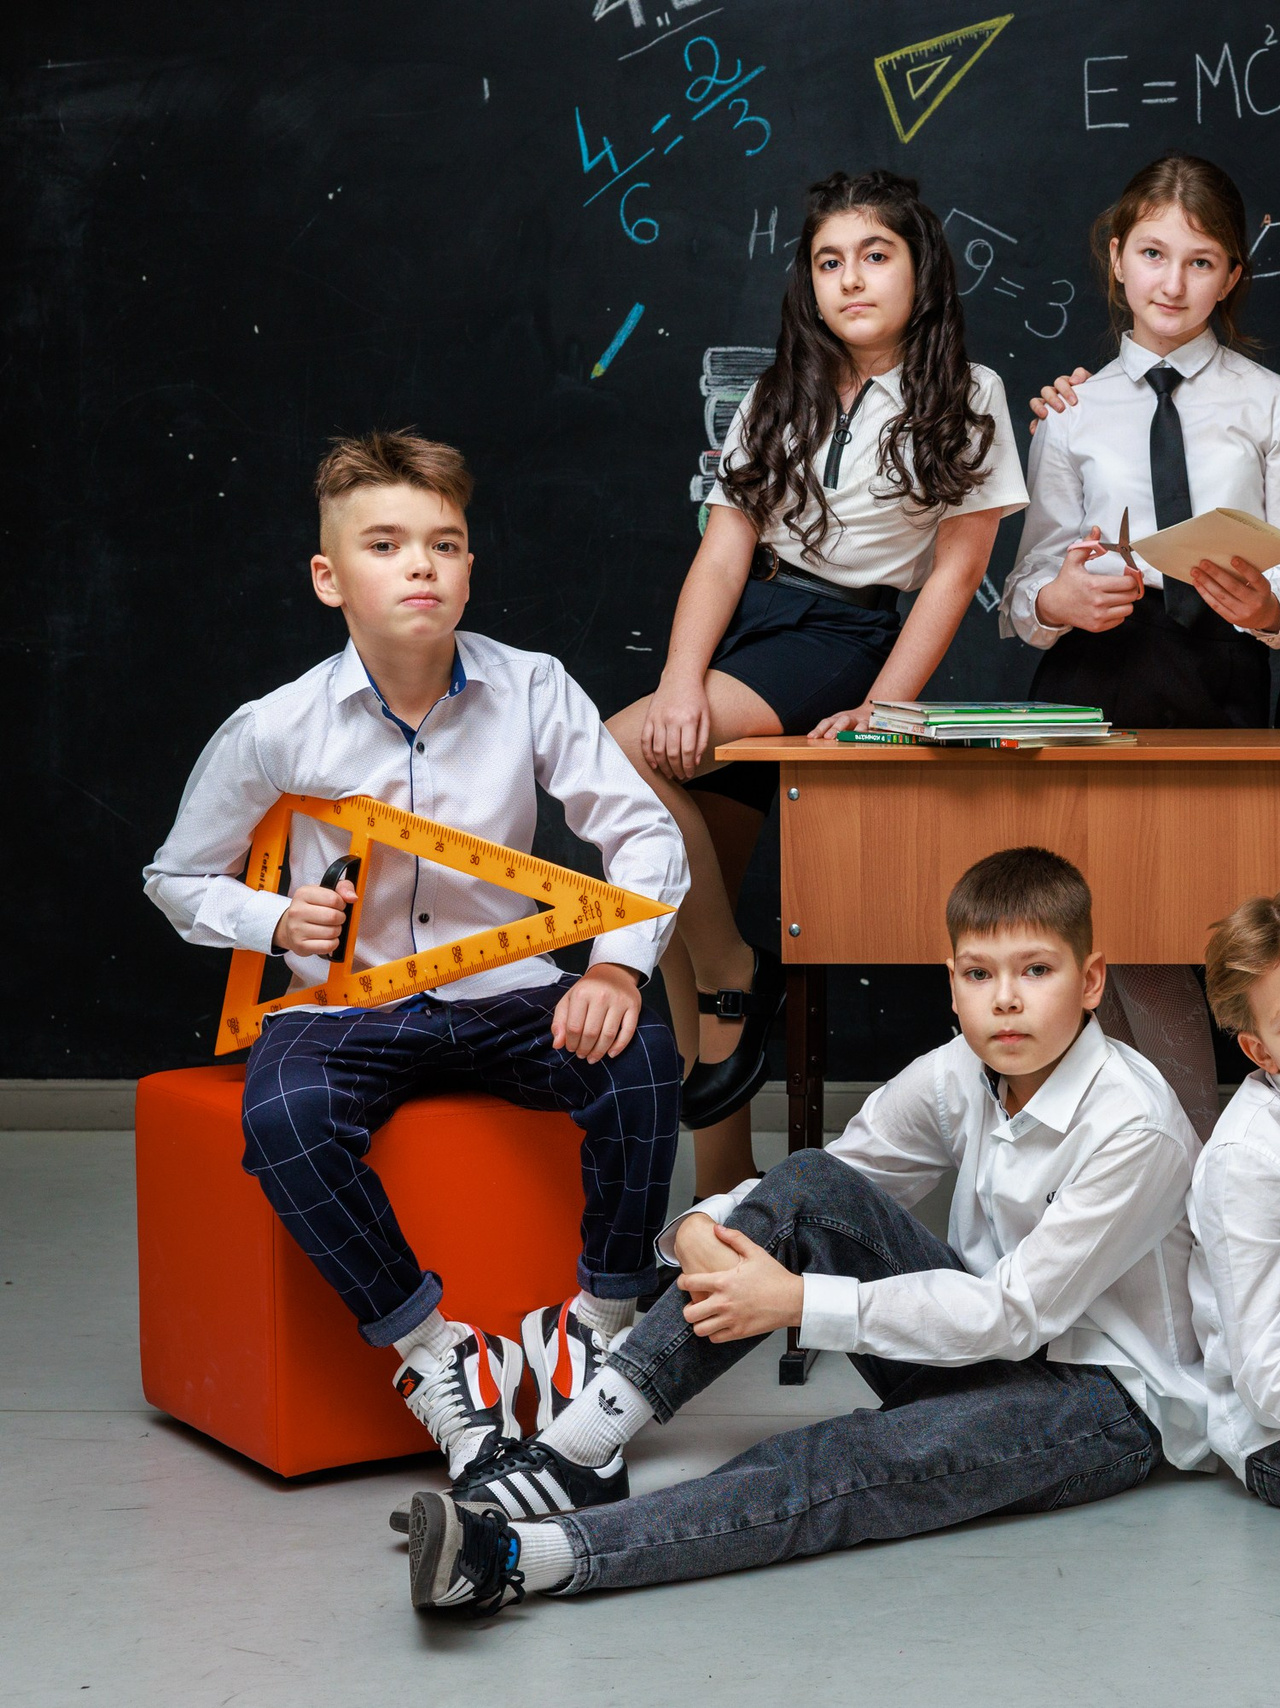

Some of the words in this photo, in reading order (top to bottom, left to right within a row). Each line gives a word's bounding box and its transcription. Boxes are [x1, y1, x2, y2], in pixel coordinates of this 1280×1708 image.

[684, 36, 741, 102] 2
[576, 107, 620, 174] 4
[728, 98, 771, 156] 3
[620, 183, 659, 245] 6
[1025, 280, 1075, 338] 3
[333, 804, 342, 815] 10
[367, 817, 375, 827] 15
[400, 829, 410, 840] 20
[435, 842, 445, 853] 25
[470, 855, 480, 866] 30
[506, 868, 516, 879] 35
[541, 881, 552, 892] 40
[578, 895, 588, 905] 45
[615, 907, 625, 919] 50
[500, 938, 510, 948] 20
[544, 915, 555, 925] 20
[546, 922, 556, 933] 10
[359, 974, 371, 986] 100
[363, 983, 373, 992] 50
